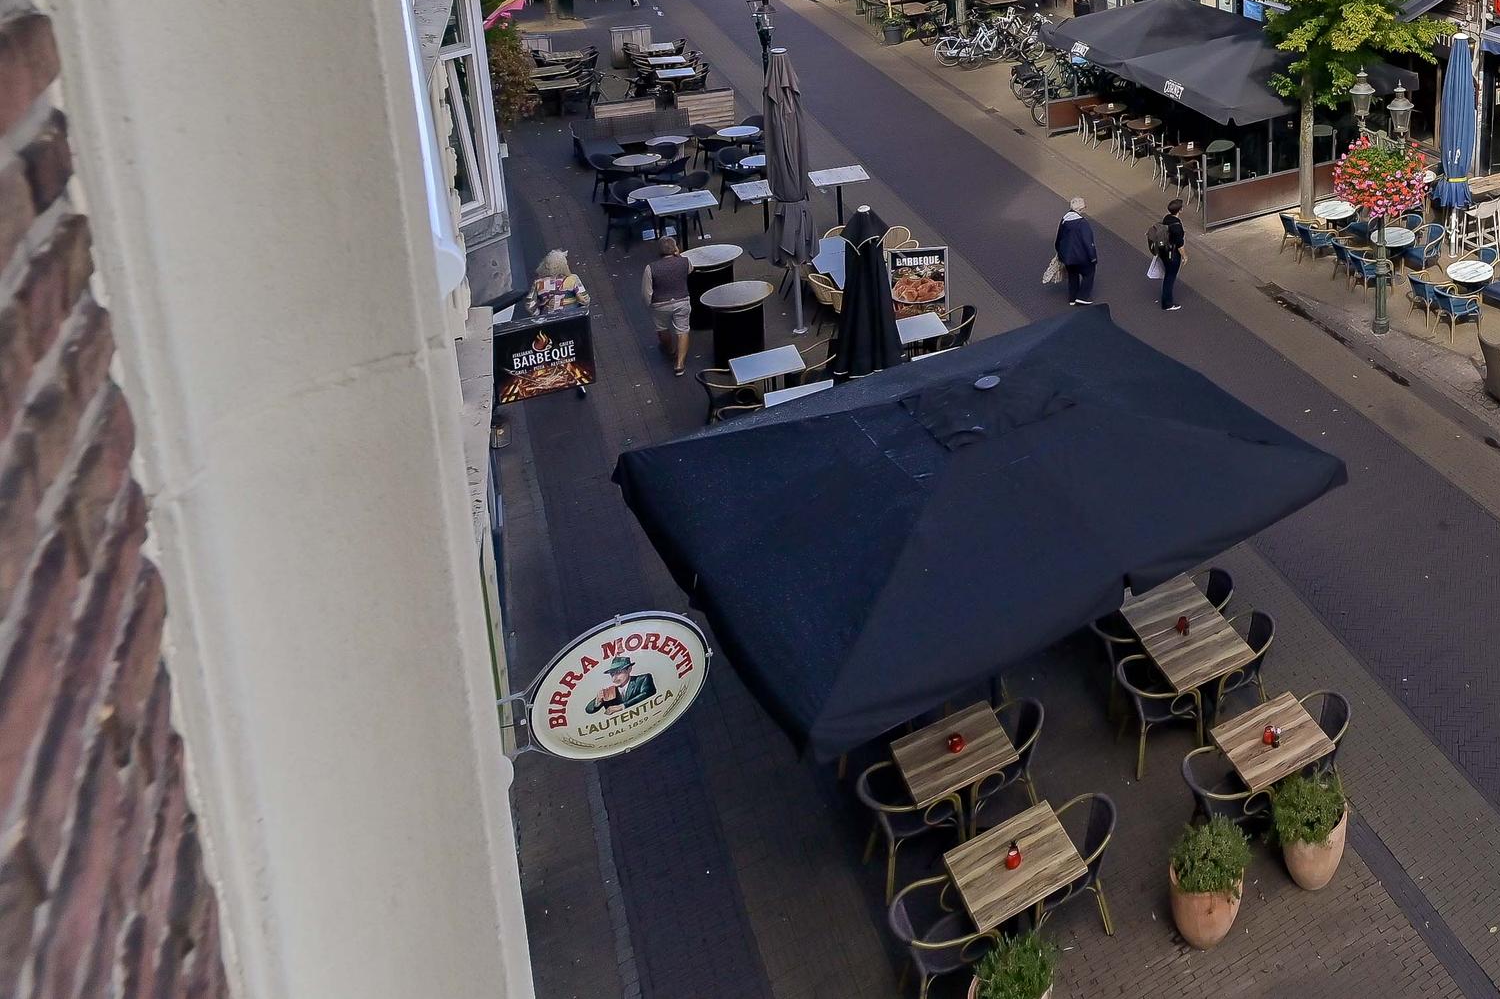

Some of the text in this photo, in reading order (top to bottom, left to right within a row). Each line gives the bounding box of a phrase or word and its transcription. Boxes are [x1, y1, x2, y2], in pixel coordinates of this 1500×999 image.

[896, 255, 940, 267] BARBEQUE
[513, 345, 576, 370] BARBEQUE
[548, 633, 694, 730] BIRRA MORETTI
[577, 689, 674, 737] L'AUTENTICA
[608, 716, 649, 738] DAL 1859
